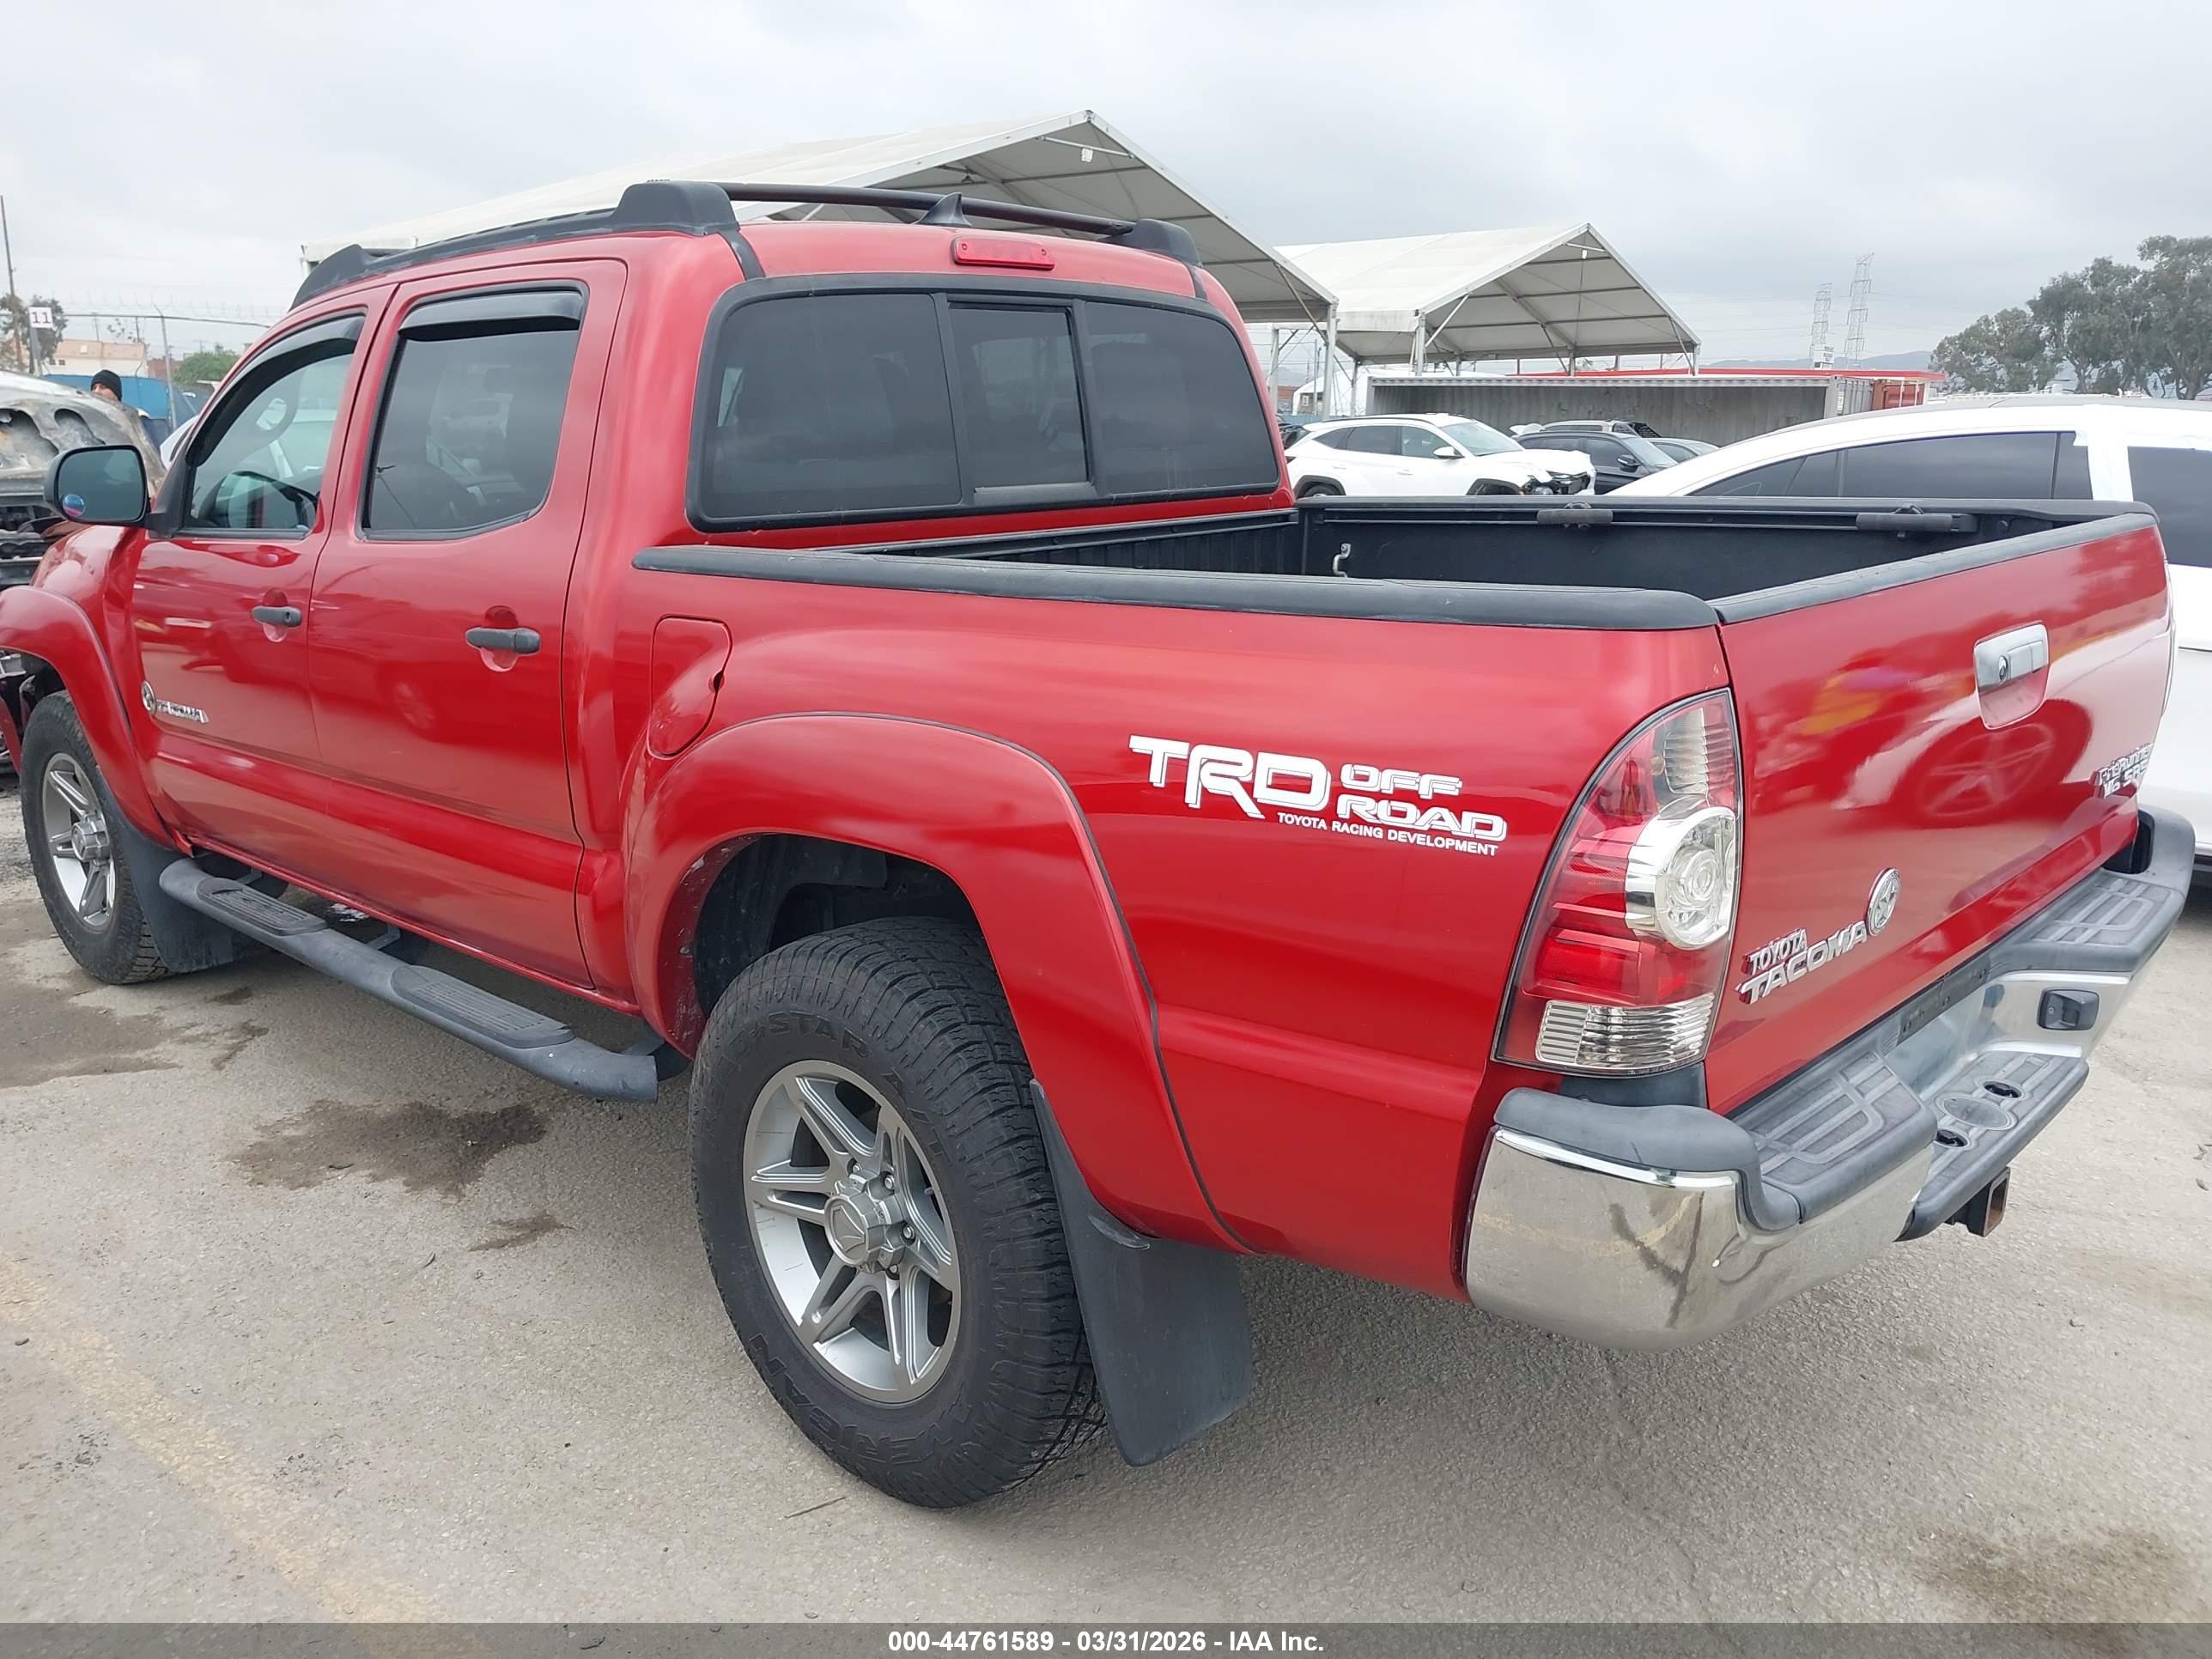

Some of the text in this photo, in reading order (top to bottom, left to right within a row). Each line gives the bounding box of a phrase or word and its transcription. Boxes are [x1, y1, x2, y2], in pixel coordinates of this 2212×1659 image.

[32, 311, 52, 324] 11
[1128, 734, 1331, 818] TRD
[1340, 763, 1462, 799] OFF
[1277, 811, 1498, 856] TOYOTA RACING DEVELOPMENT
[1336, 794, 1507, 842] ROAD
[1738, 920, 1868, 1005] TACOMA
[1747, 928, 1808, 975] TOYOTA
